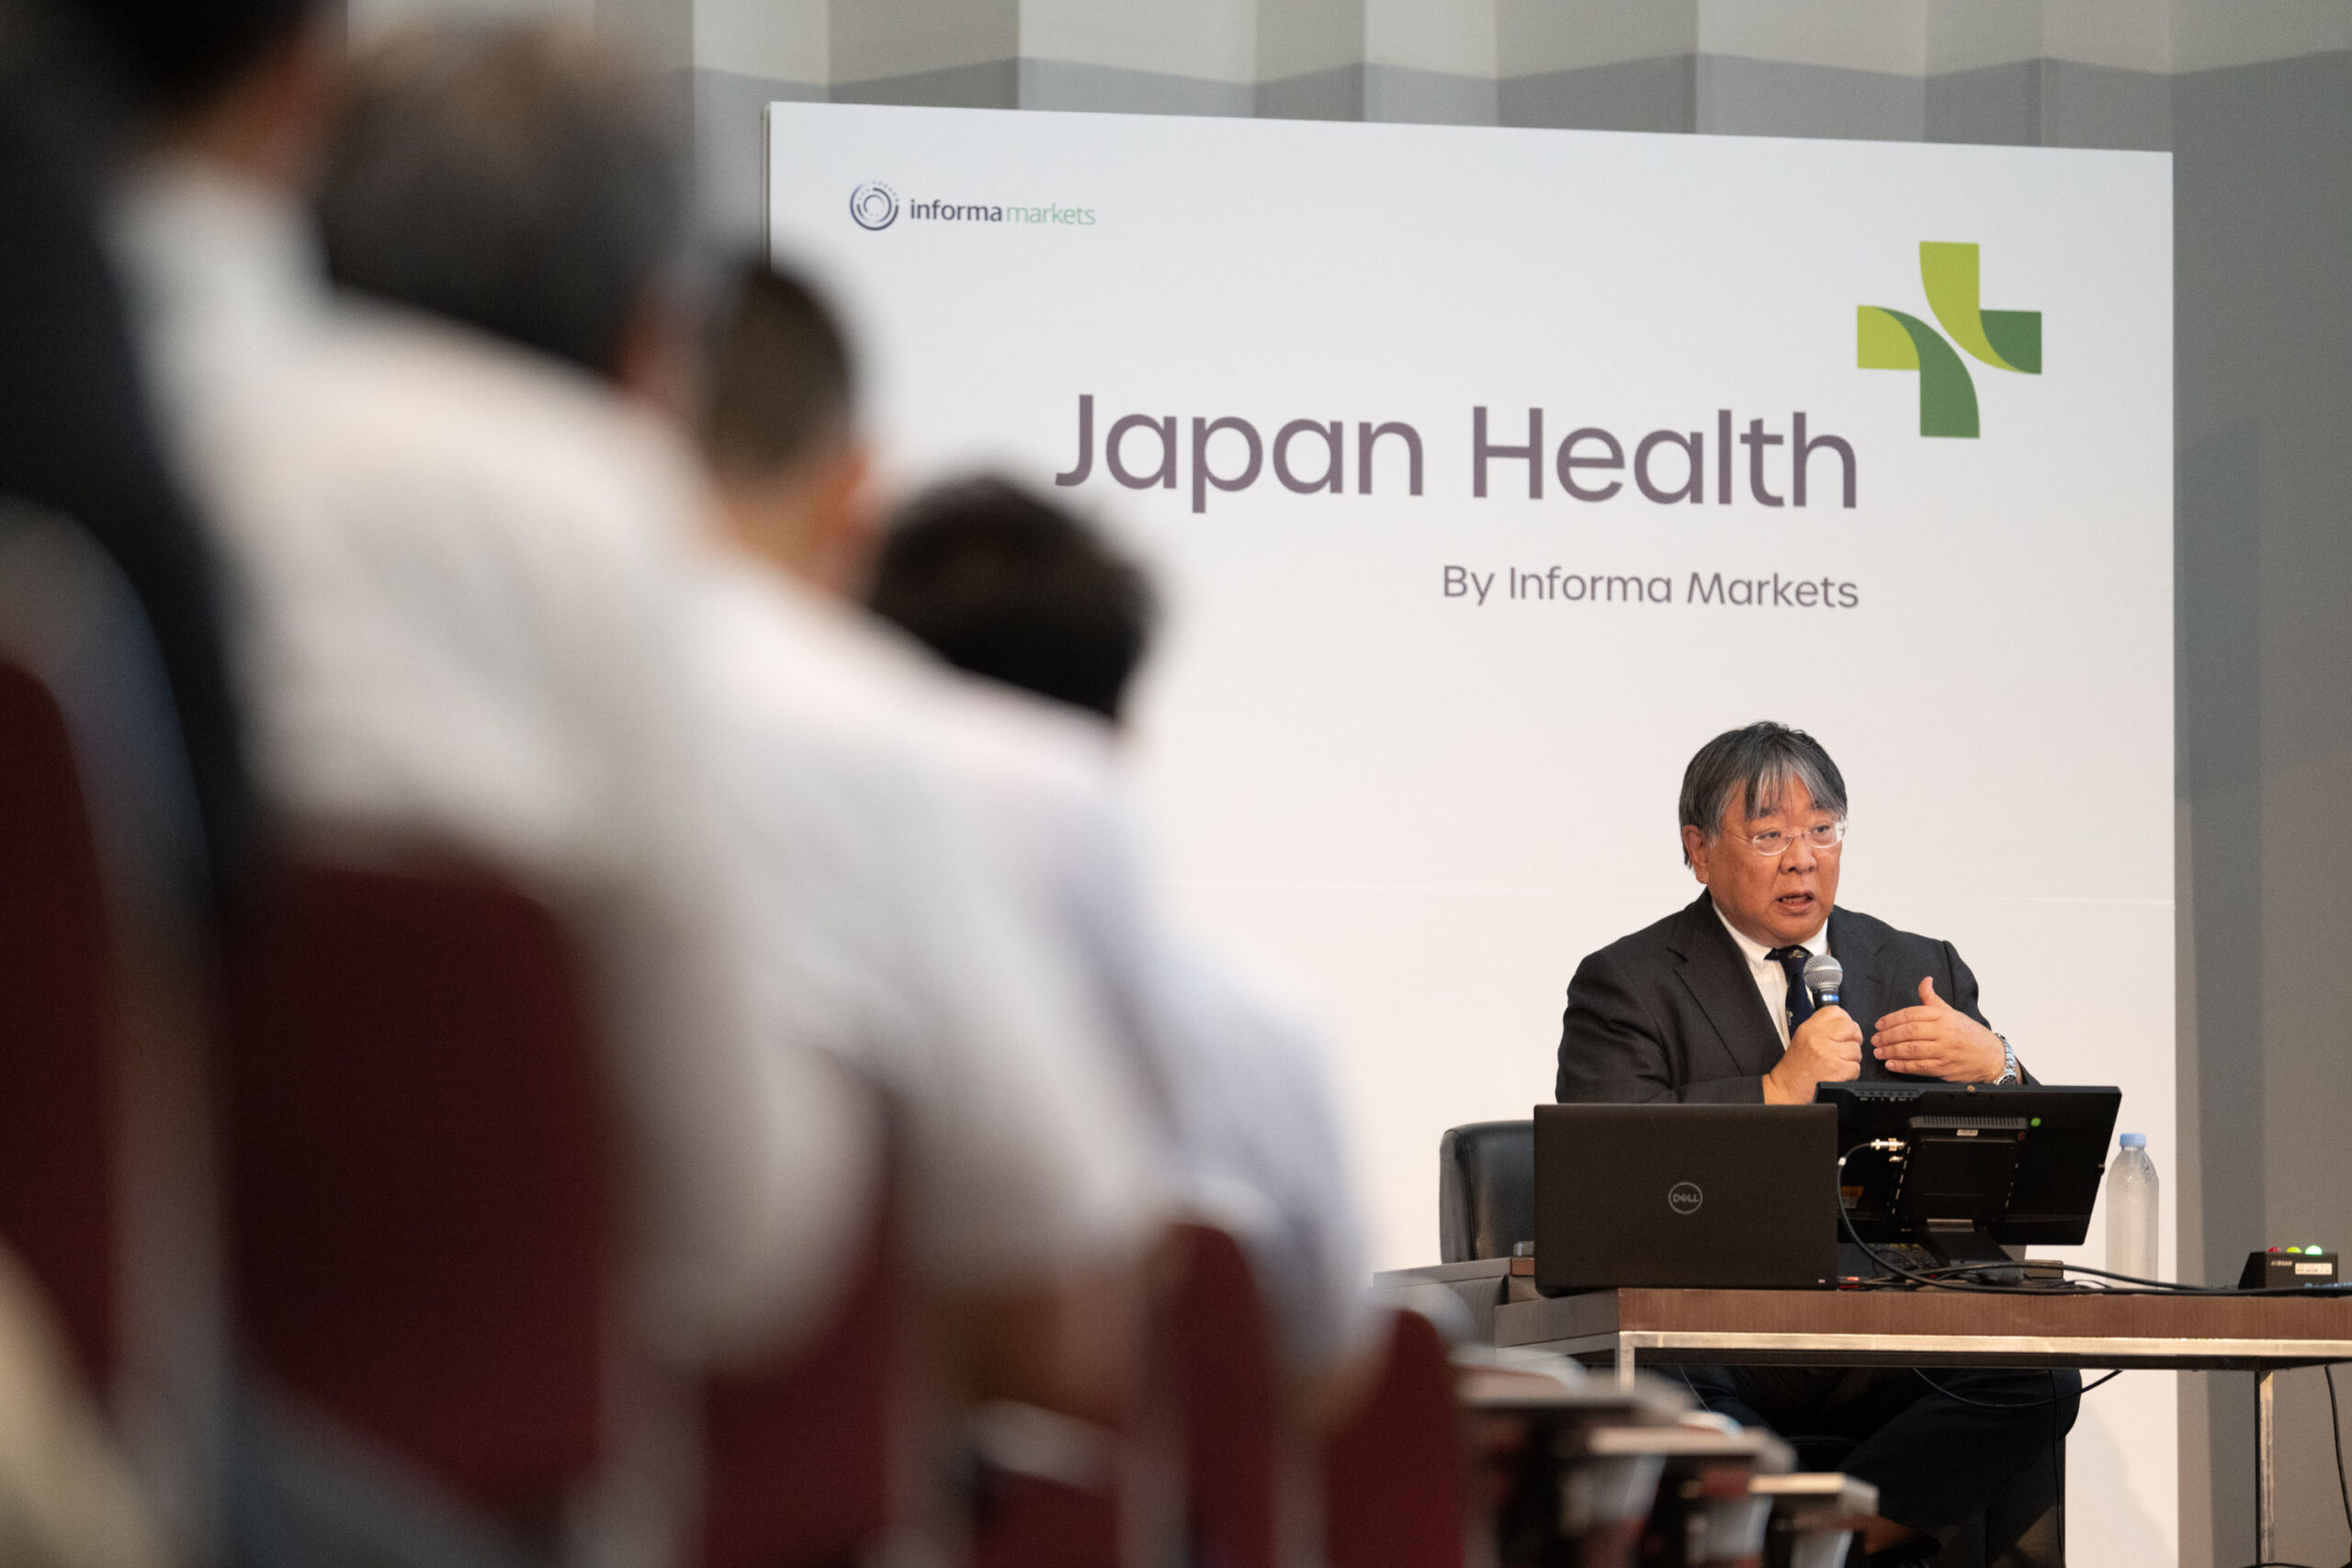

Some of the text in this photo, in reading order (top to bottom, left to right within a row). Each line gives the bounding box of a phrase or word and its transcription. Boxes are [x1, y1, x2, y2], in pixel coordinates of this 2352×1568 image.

[910, 197, 1096, 226] informa markets
[1055, 393, 1858, 514] Japan Health
[1443, 565, 1860, 609] By Informa Markets
[1672, 1193, 1700, 1203] DELL
